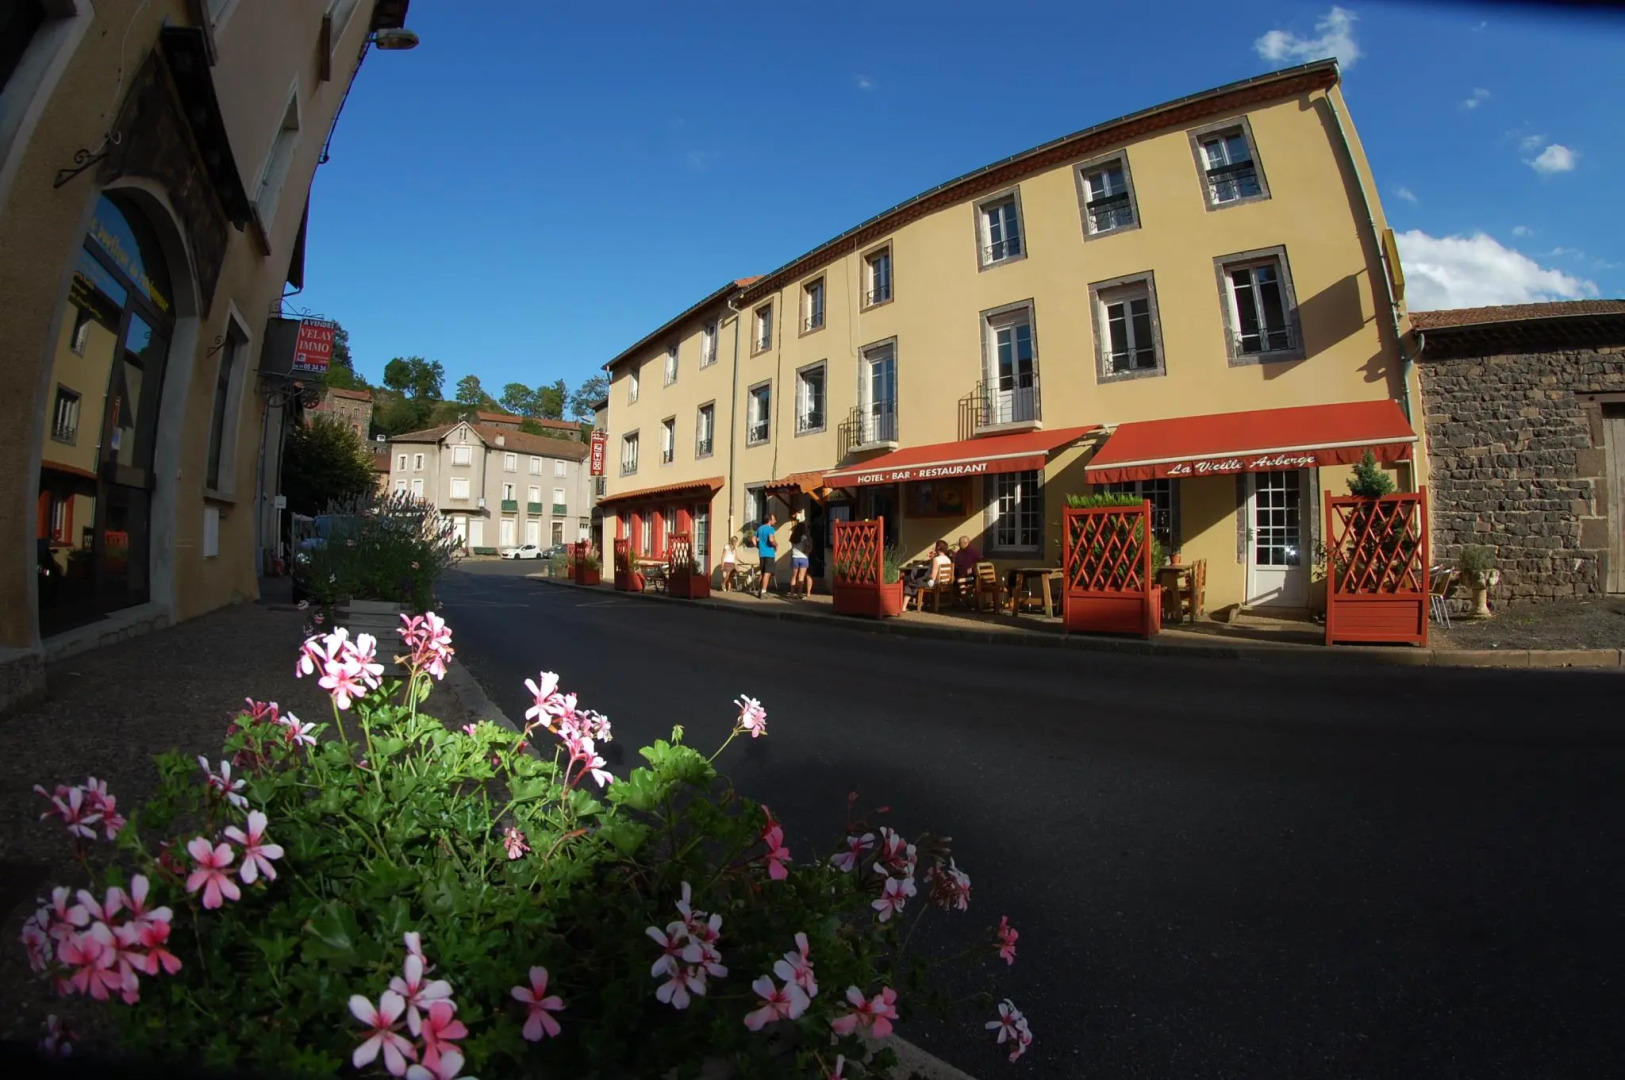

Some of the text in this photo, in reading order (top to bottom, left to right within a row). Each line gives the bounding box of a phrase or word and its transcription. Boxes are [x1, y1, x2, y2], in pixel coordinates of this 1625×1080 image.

[300, 328, 333, 341] VELAY
[299, 341, 330, 352] IMMO
[857, 462, 988, 484] HOTEL BAR RESTAURANT
[1167, 454, 1316, 475] La Vieille Auberge
